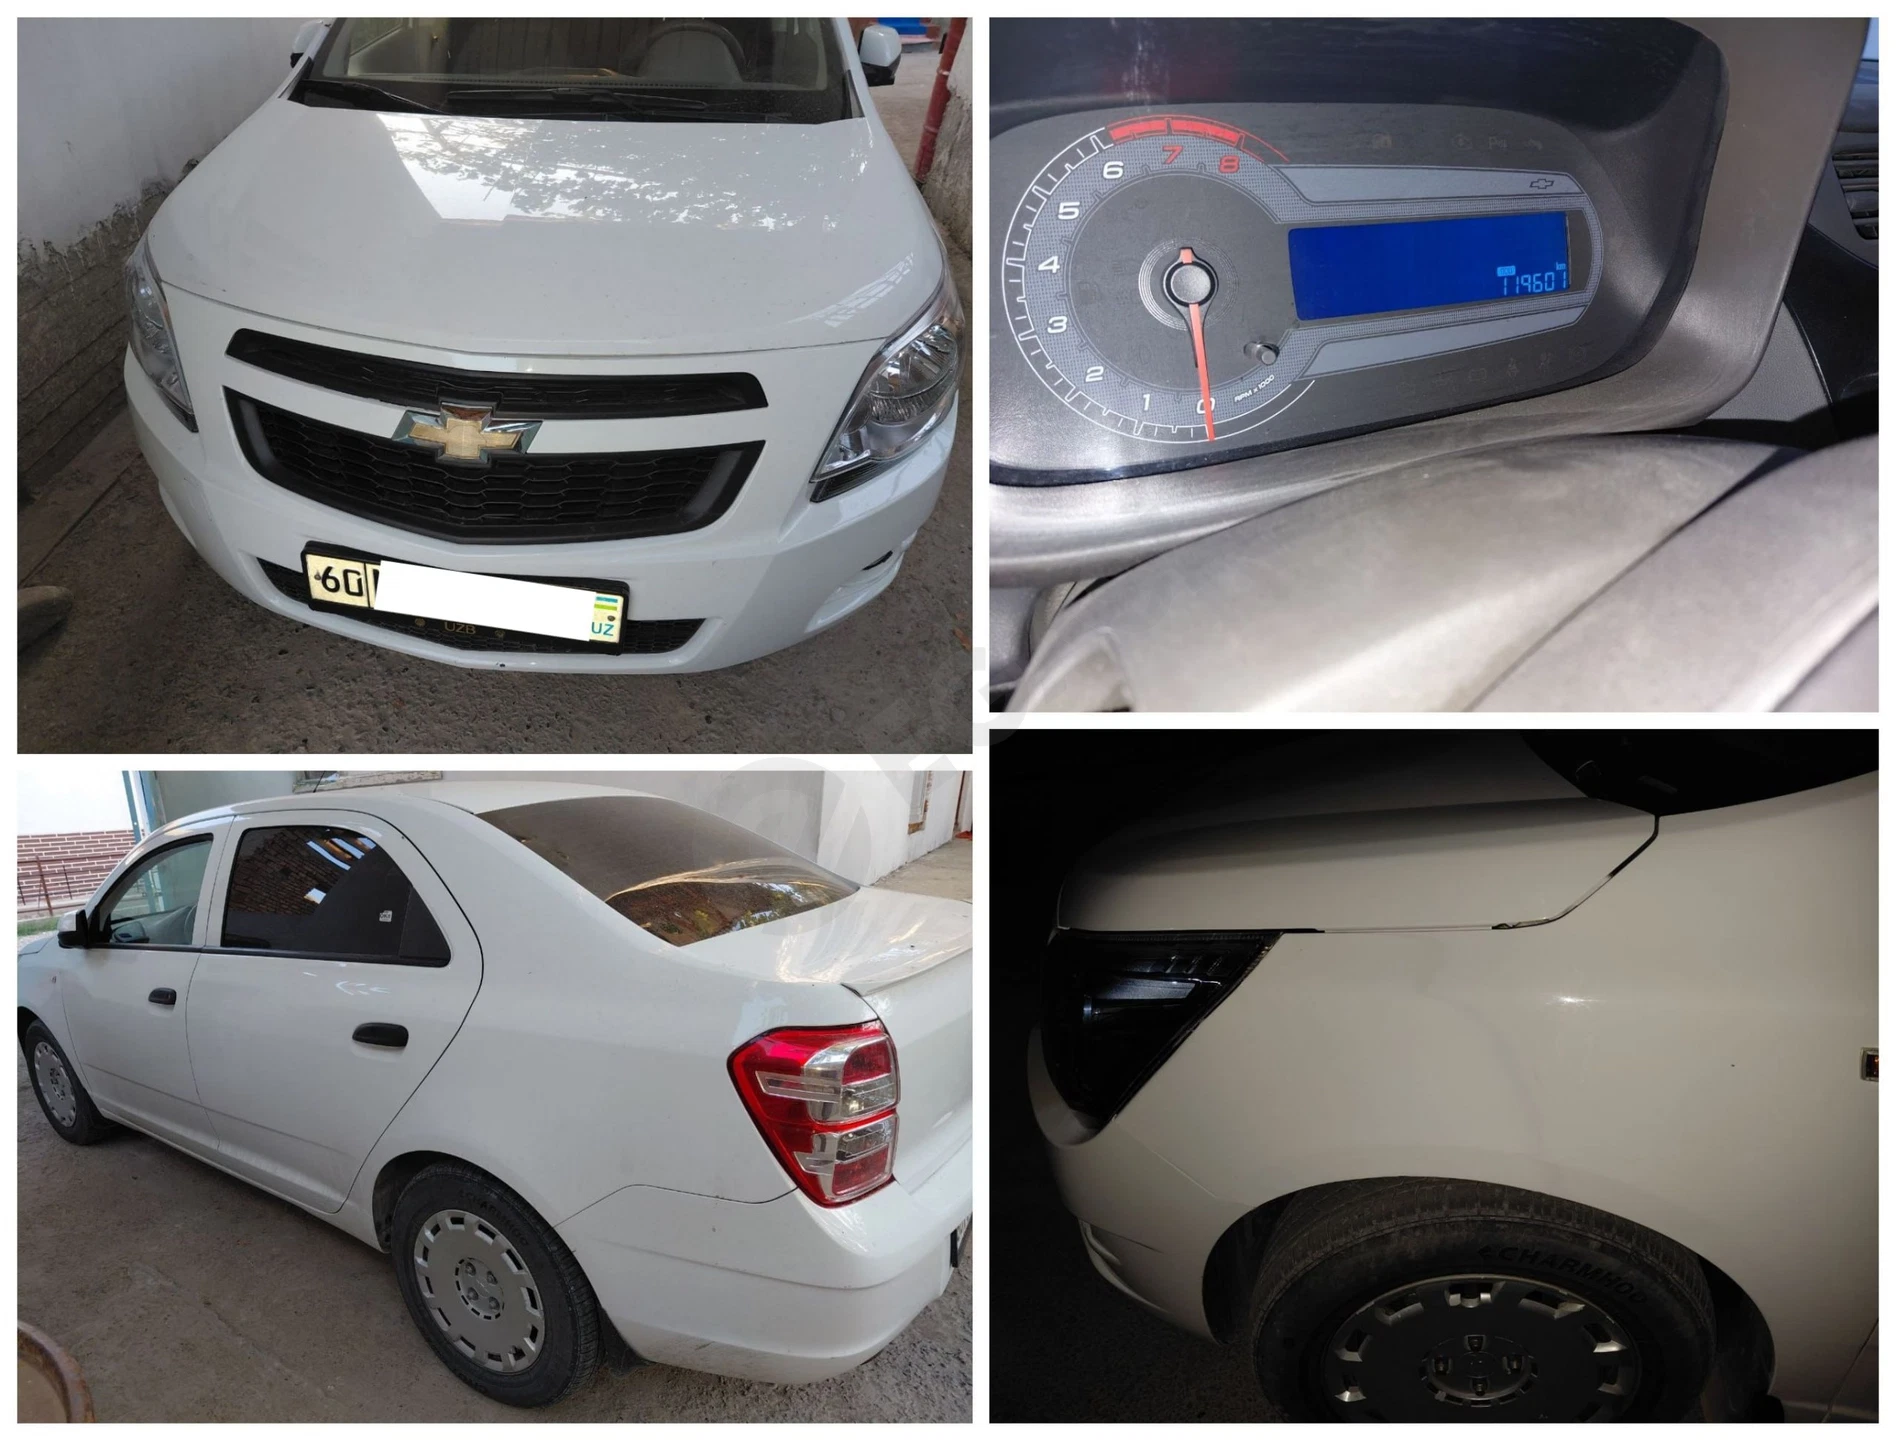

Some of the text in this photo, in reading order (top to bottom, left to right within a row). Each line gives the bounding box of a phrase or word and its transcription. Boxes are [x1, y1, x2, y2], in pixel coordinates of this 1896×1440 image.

[1162, 145, 1184, 165] 7
[1219, 155, 1240, 173] 8
[1102, 161, 1124, 180] 6
[1057, 201, 1081, 220] 5
[1038, 256, 1061, 274] 4
[1503, 271, 1566, 296] 119601
[1047, 315, 1068, 334] 3
[1085, 366, 1105, 382] 2
[1234, 389, 1253, 403] RPM
[1258, 374, 1275, 390] 1000
[1142, 393, 1151, 411] 1
[1196, 397, 1216, 415] 0
[321, 565, 364, 598] 60
[443, 621, 477, 635] UZB
[591, 621, 615, 637] UZ
